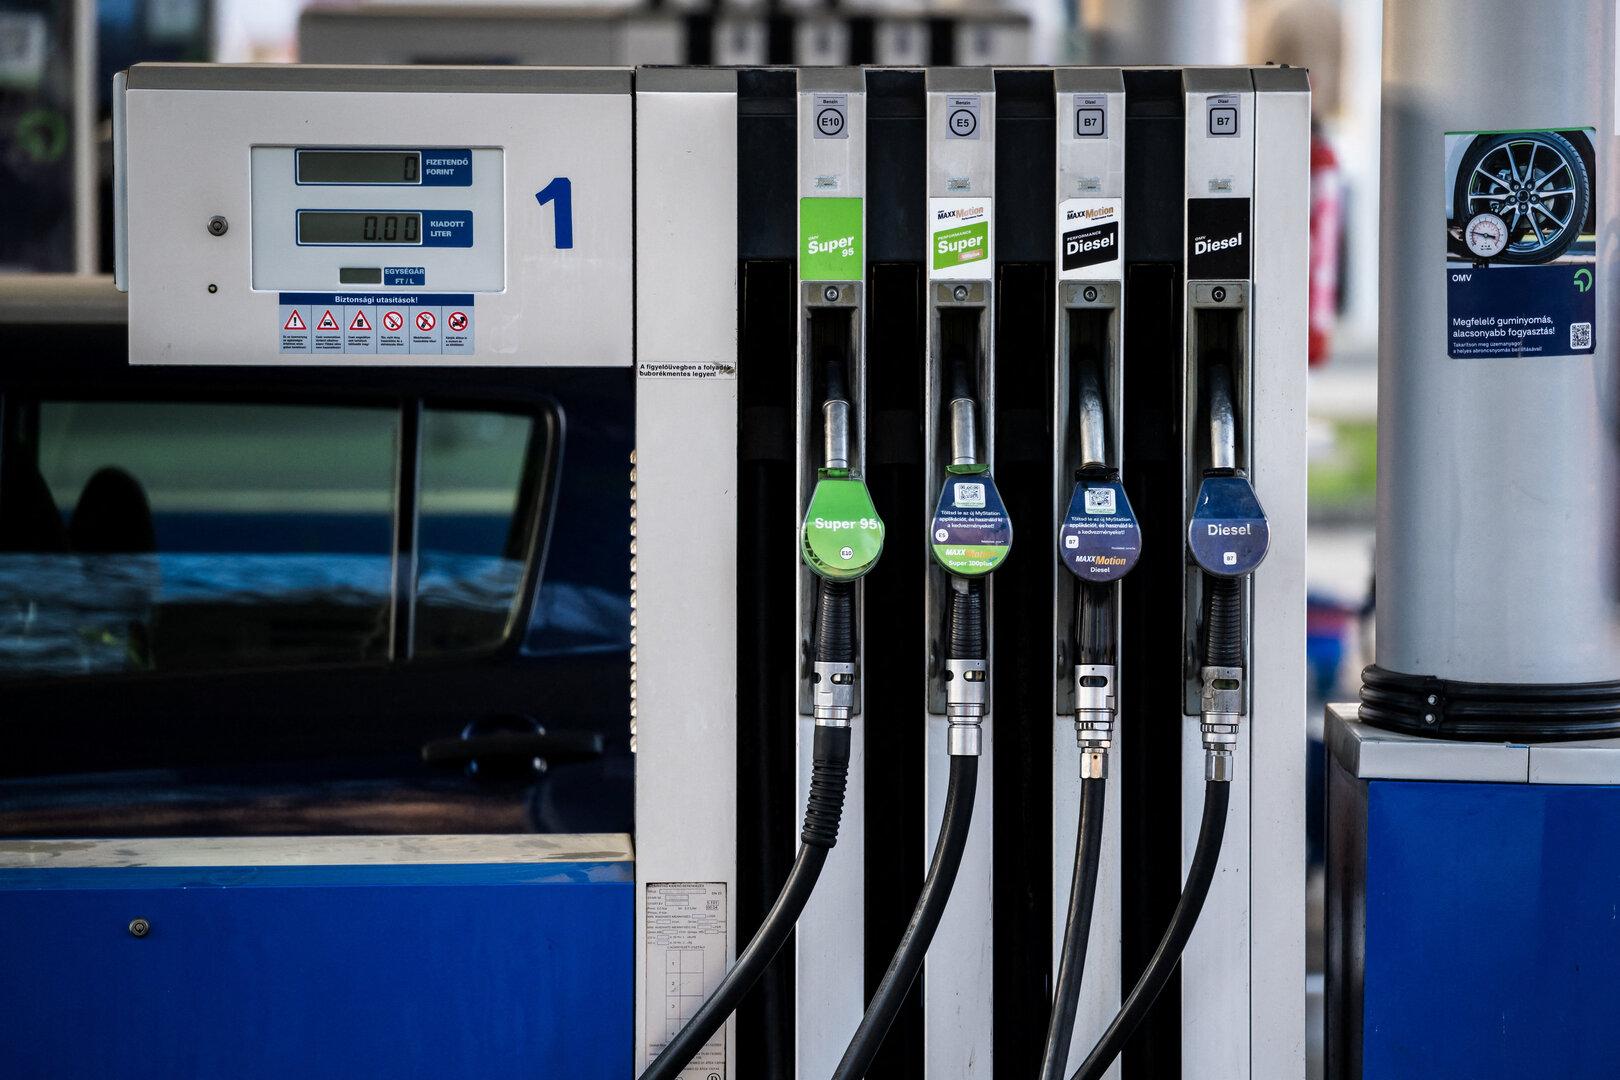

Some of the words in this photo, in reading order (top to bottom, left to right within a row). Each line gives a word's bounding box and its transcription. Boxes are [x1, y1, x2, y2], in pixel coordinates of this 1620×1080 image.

[821, 118, 840, 126] E10
[956, 119, 970, 127] E5
[1217, 118, 1230, 126] B7
[404, 157, 418, 180] 0
[535, 177, 574, 249] 1
[937, 206, 984, 220] MAXXMotion
[1066, 206, 1114, 220] MAXXMotion
[363, 216, 418, 241] 0.00
[1066, 230, 1102, 242] PERFORMANCE
[808, 236, 855, 254] Super
[937, 235, 984, 254] Super
[1067, 232, 1114, 255] Diesel
[1195, 232, 1242, 255] Diesel
[841, 247, 855, 257] 95
[1452, 274, 1472, 282] OMV
[334, 296, 374, 304] Biztonsági
[1452, 317, 1495, 327] Megfelelő
[1497, 315, 1553, 327] guminyomás,
[1452, 329, 1506, 338] alacsonyabb
[1507, 327, 1555, 337] fogyasztás!
[815, 518, 856, 531] Super
[860, 518, 877, 529] 95
[1208, 524, 1251, 536] Diesel
[1076, 556, 1127, 565] MAXXMotion
